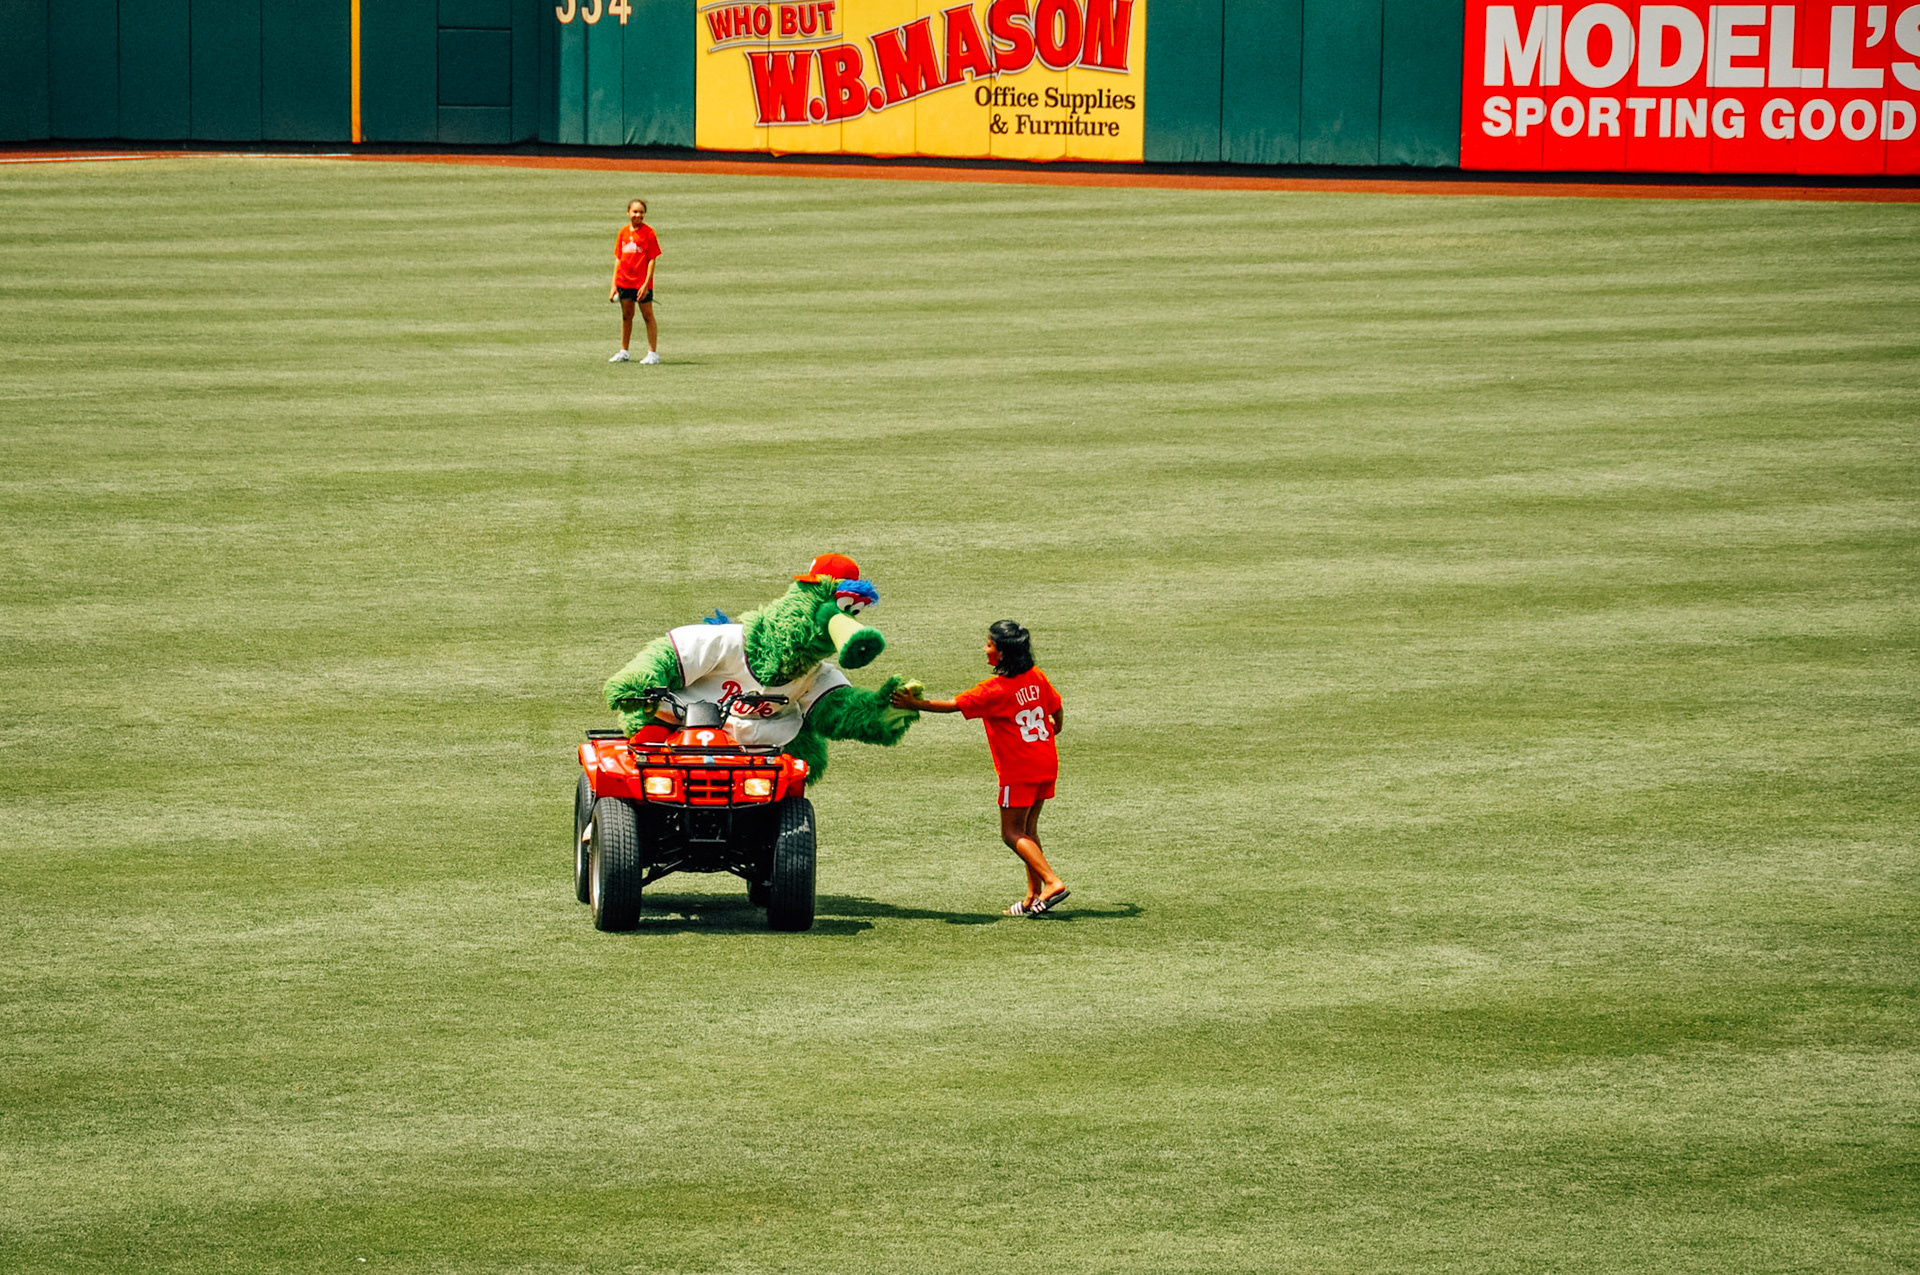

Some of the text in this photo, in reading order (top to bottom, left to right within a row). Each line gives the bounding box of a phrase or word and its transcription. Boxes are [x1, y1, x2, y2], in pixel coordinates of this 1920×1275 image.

[708, 2, 836, 42] WHO BUT
[975, 86, 1136, 114] Office Supplies
[989, 114, 1120, 137] & Furniture
[1482, 95, 1746, 140] SPORTING
[1015, 684, 1040, 706] UTLEY
